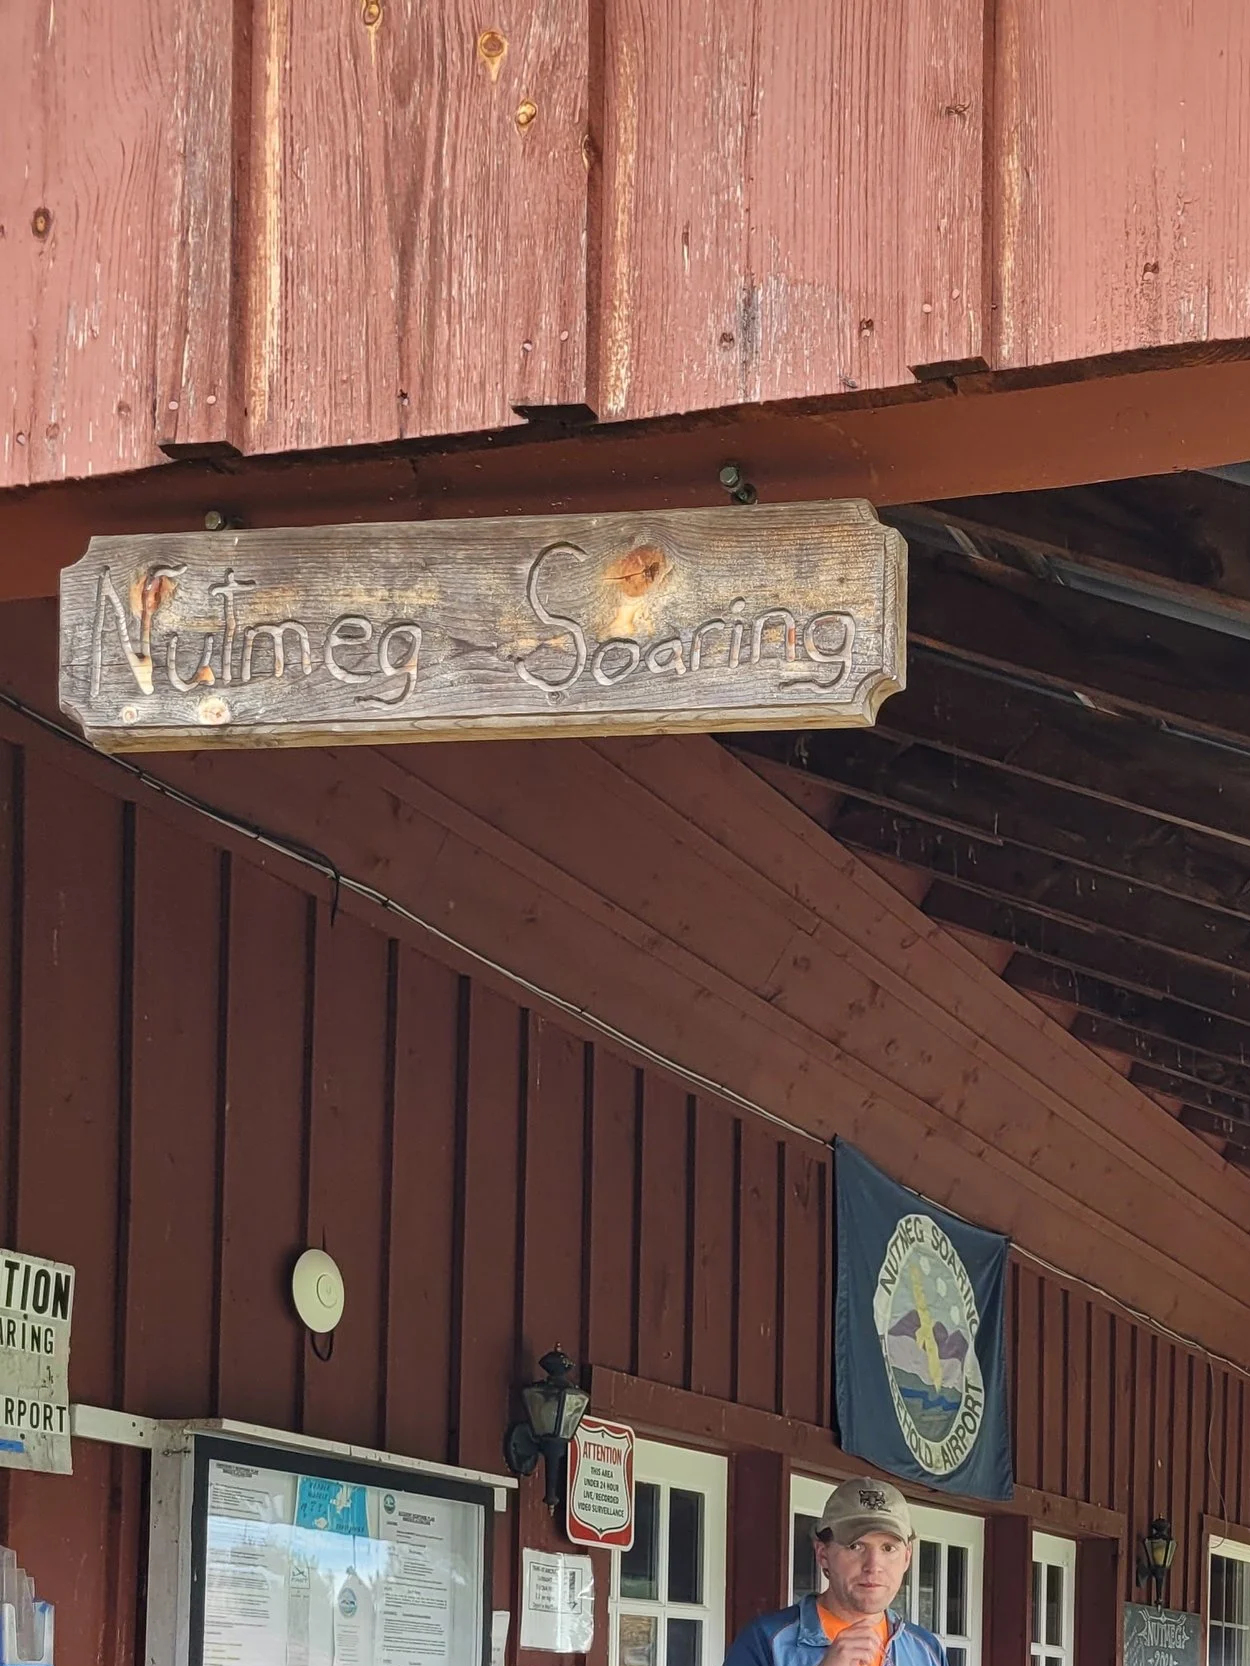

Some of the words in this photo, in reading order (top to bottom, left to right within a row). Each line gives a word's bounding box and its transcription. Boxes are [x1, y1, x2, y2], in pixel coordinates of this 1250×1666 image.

[90, 563, 423, 705] Nutmeg
[513, 540, 857, 692] Soaring
[880, 1216, 925, 1296] NUTMEG
[4, 1259, 71, 1320] TION
[940, 1377, 983, 1471] AIRPORT
[583, 1441, 622, 1466] ATTENTION
[583, 1478, 599, 1488] UNDER
[600, 1480, 606, 1490] 24
[607, 1482, 619, 1492] HOUR
[591, 1466, 601, 1476] THIS
[602, 1469, 613, 1479] AREA
[578, 1502, 591, 1512] VIDEO
[592, 1504, 624, 1518] SURVEILLANCE
[1147, 1622, 1183, 1649] NUTMEG
